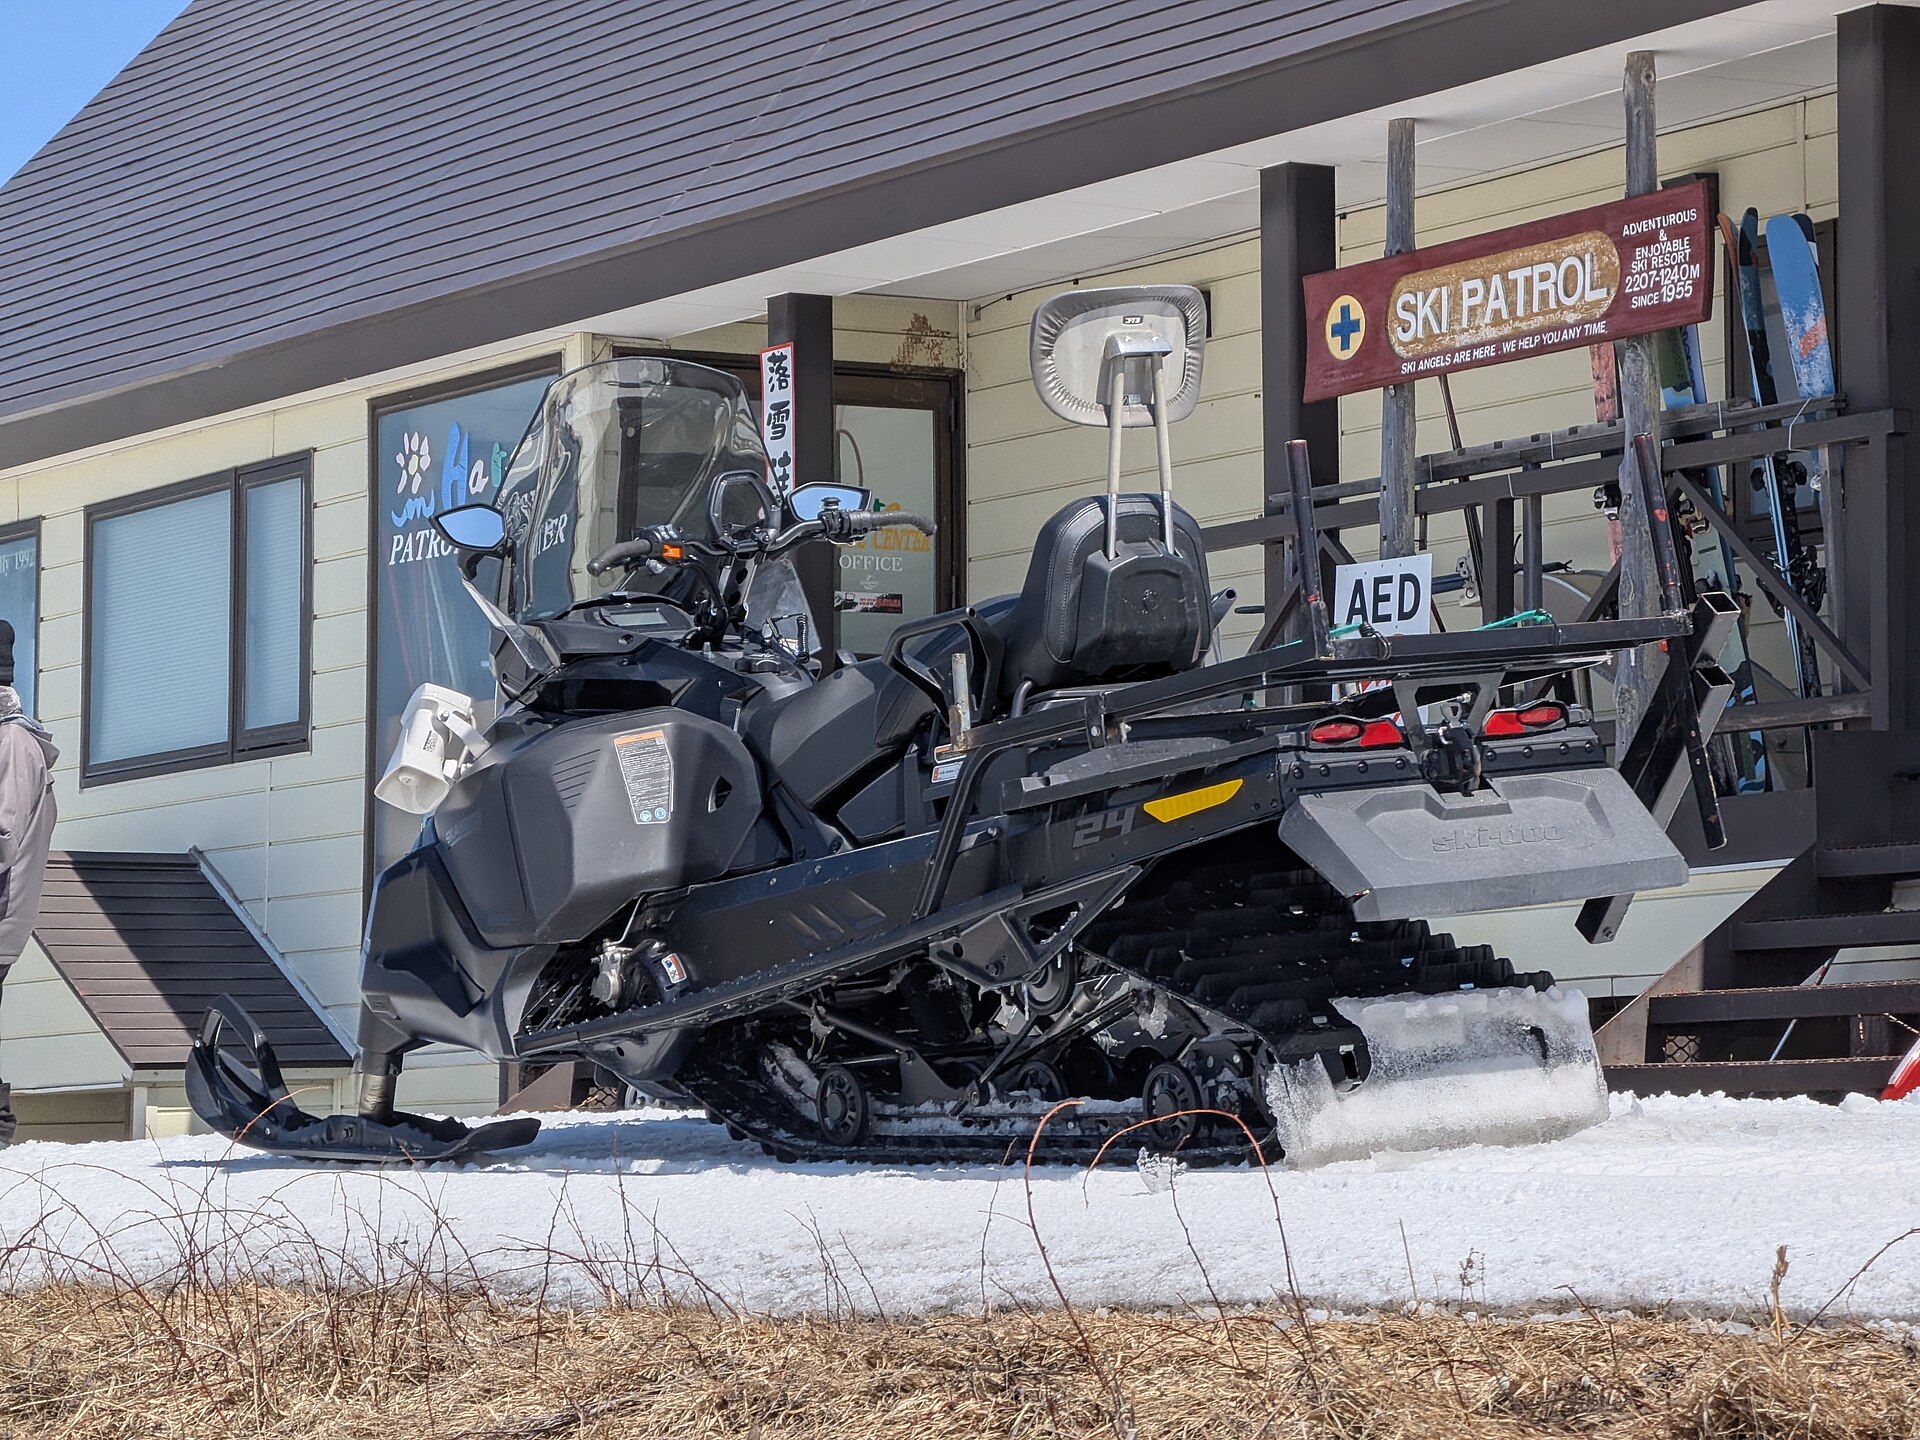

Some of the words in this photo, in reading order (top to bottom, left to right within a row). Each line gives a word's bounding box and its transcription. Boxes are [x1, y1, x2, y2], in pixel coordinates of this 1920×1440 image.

[1622, 208, 1697, 236] ADVENTUROUS
[1659, 229, 1667, 241] &
[1631, 258, 1648, 273] SKI
[1651, 249, 1691, 269] RESORT
[1635, 237, 1690, 260] ENJOYABLE
[1625, 263, 1700, 293] 2207-1240M
[1396, 285, 1450, 342] SKI
[1461, 252, 1608, 329] PATROL
[1631, 292, 1660, 308] SINCE
[1660, 280, 1693, 303] 1955
[1401, 361, 1416, 375] SKI
[1417, 353, 1451, 371] ANGELS
[1453, 348, 1471, 364] ARE
[1518, 334, 1541, 351] HELP
[1542, 329, 1560, 345] YOU
[1561, 325, 1582, 342] ANY
[766, 350, 792, 492] 落雪注
[388, 528, 459, 566] PATRO
[838, 554, 903, 572] OFFICE
[1345, 572, 1421, 626] AED
[1072, 806, 1136, 849] 24
